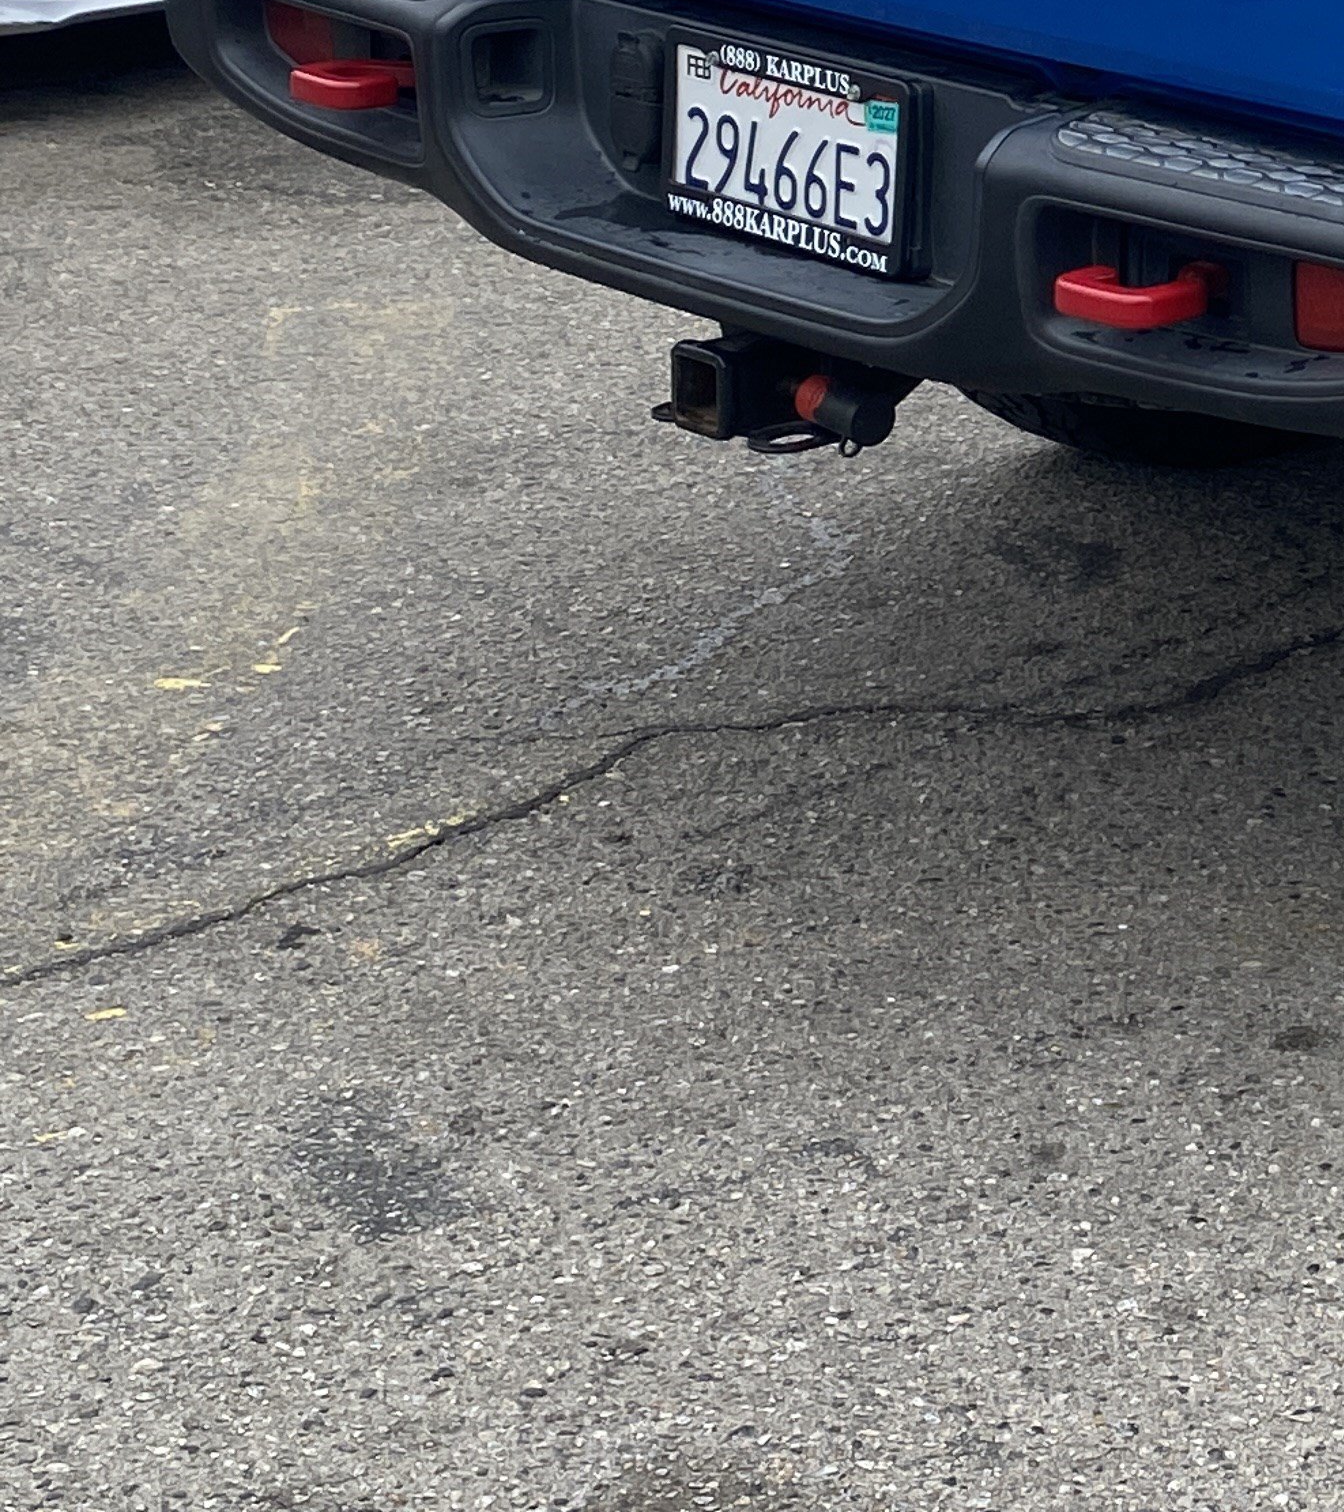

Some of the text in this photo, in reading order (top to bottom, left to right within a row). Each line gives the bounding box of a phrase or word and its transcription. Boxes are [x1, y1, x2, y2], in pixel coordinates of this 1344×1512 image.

[719, 68, 864, 126] California
[720, 44, 851, 95] (888) KARPLUS
[684, 106, 891, 236] 29466E3
